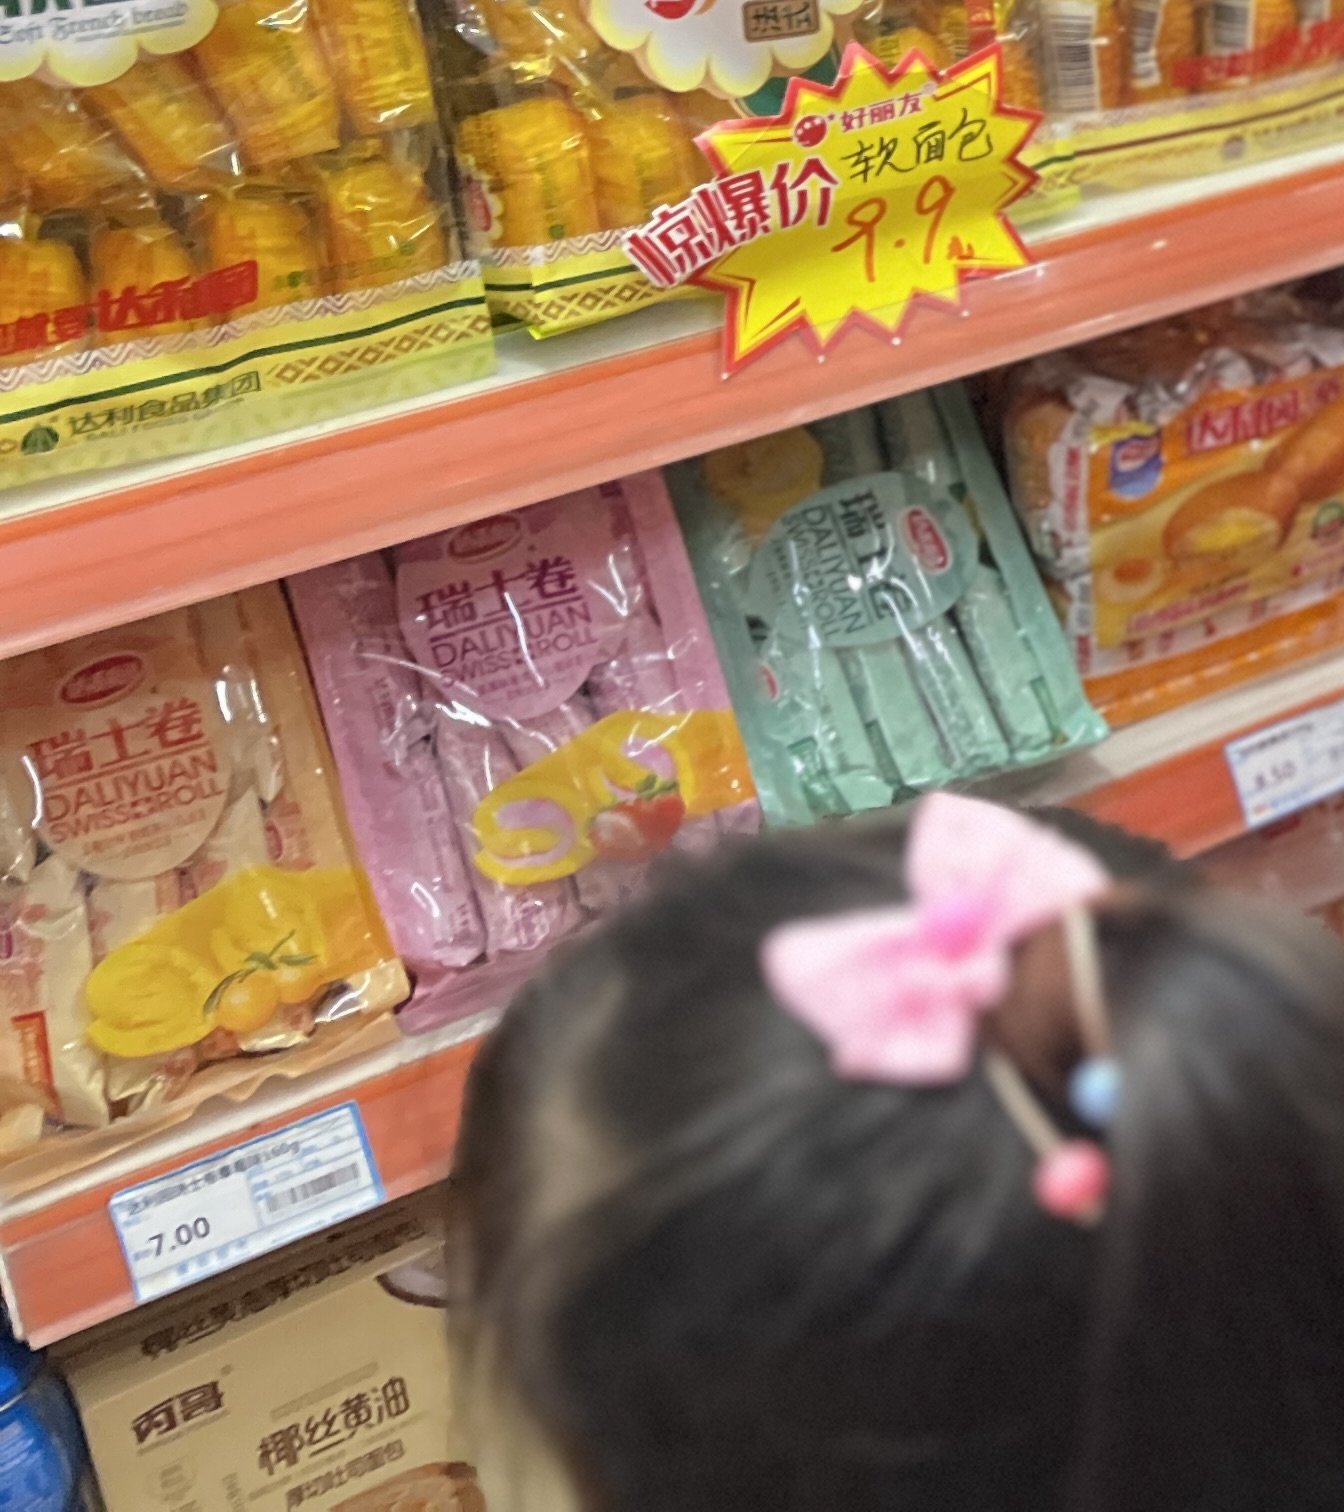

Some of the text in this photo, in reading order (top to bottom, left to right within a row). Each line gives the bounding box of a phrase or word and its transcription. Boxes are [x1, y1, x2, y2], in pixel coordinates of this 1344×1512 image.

[752, 0, 813, 36] 法式
[839, 91, 924, 133] 好丽友
[841, 106, 994, 183] 软面包
[624, 156, 839, 287] 惊爆价
[830, 174, 957, 284] 9.9
[67, 370, 262, 438] 达利食品集团
[415, 555, 579, 629] 瑞士卷
[801, 505, 866, 635] DALIYUAN
[431, 601, 593, 669] DALIYUAN
[27, 696, 204, 781] 瑞士卷
[45, 747, 218, 825] DALIYUAN
[148, 1216, 211, 1257] 7.00
[256, 1375, 411, 1476] 椰丝黄油
